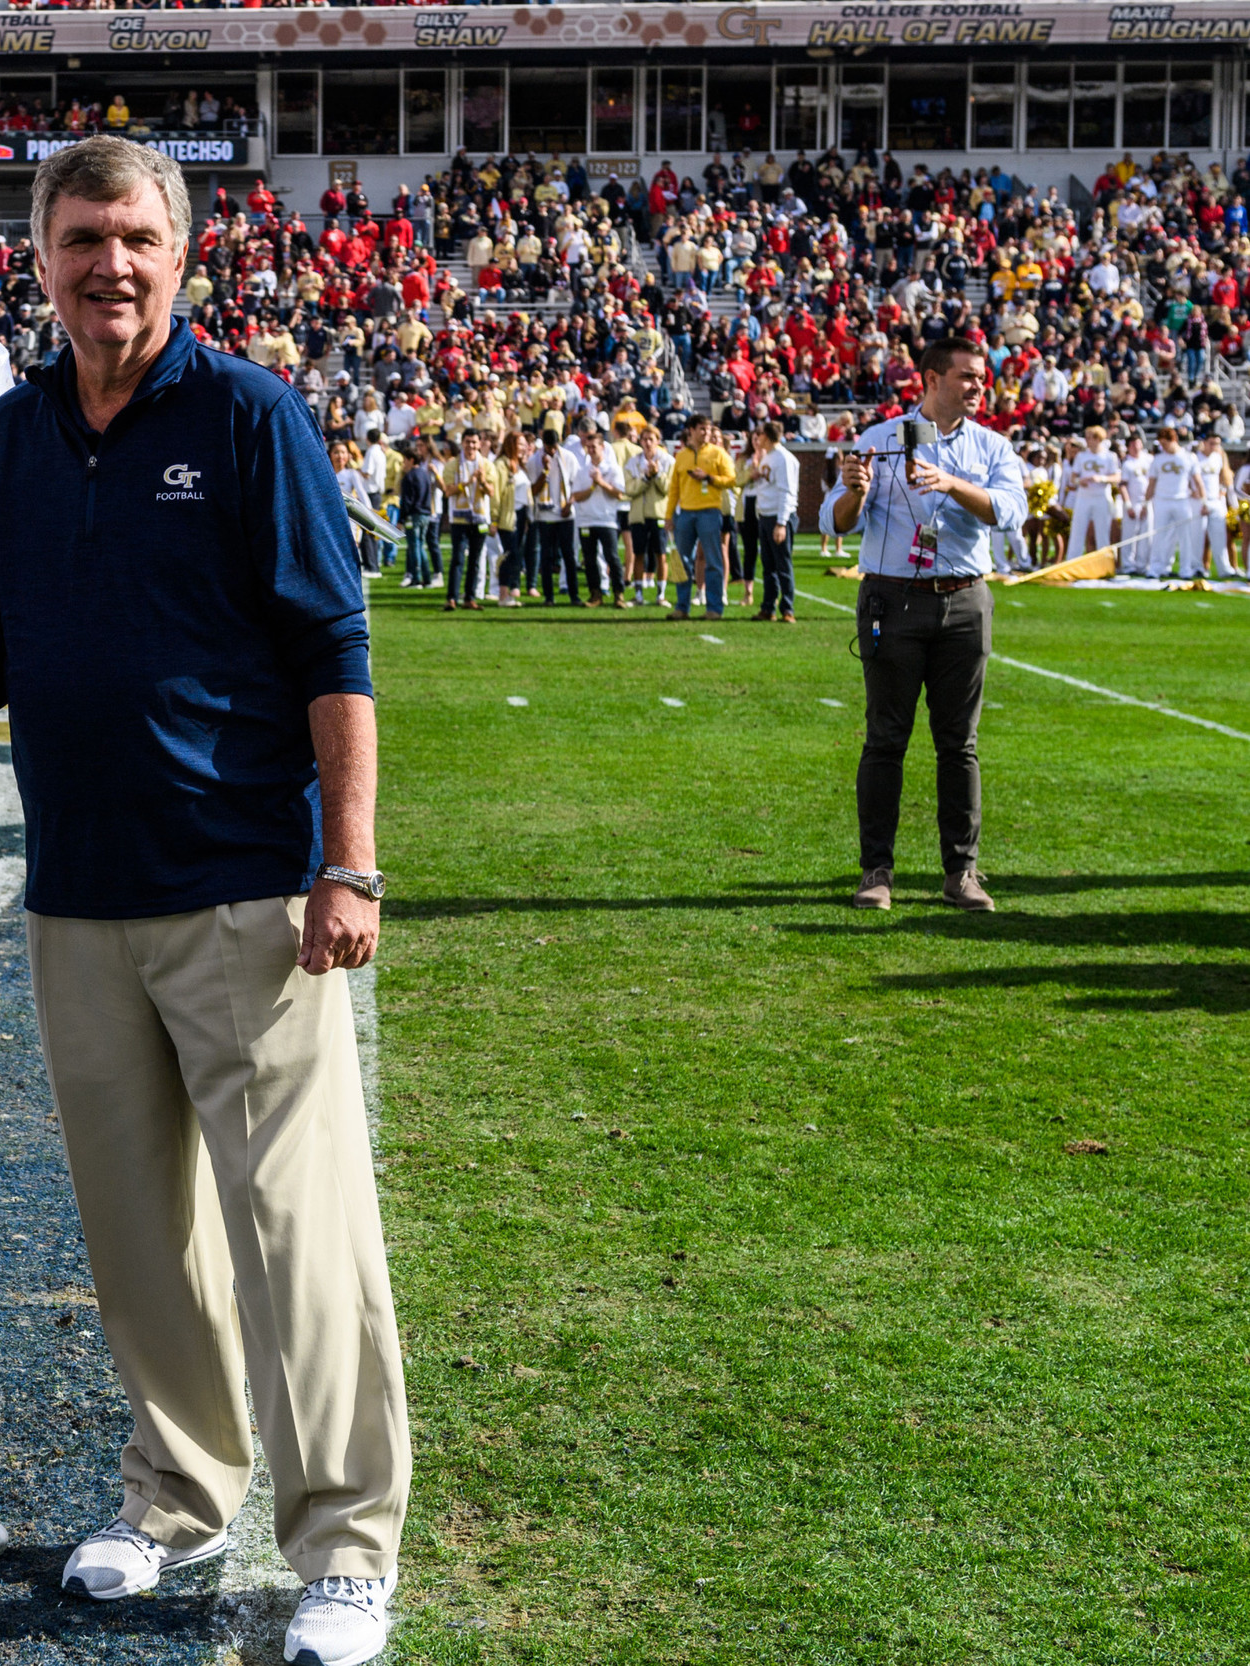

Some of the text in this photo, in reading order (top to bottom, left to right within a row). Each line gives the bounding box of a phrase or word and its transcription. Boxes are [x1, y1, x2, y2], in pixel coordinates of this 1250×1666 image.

[841, 4, 1023, 18] COLLEGE FOOTBALL
[1109, 5, 1175, 21] MAXIE
[108, 16, 144, 31] JOE
[414, 13, 467, 28] BILLY
[414, 26, 505, 46] SHAW
[807, 18, 1055, 45] HALL OF FAME
[108, 30, 211, 50] GUYON
[163, 464, 201, 488] GT
[156, 491, 205, 501] FOOTBALL
